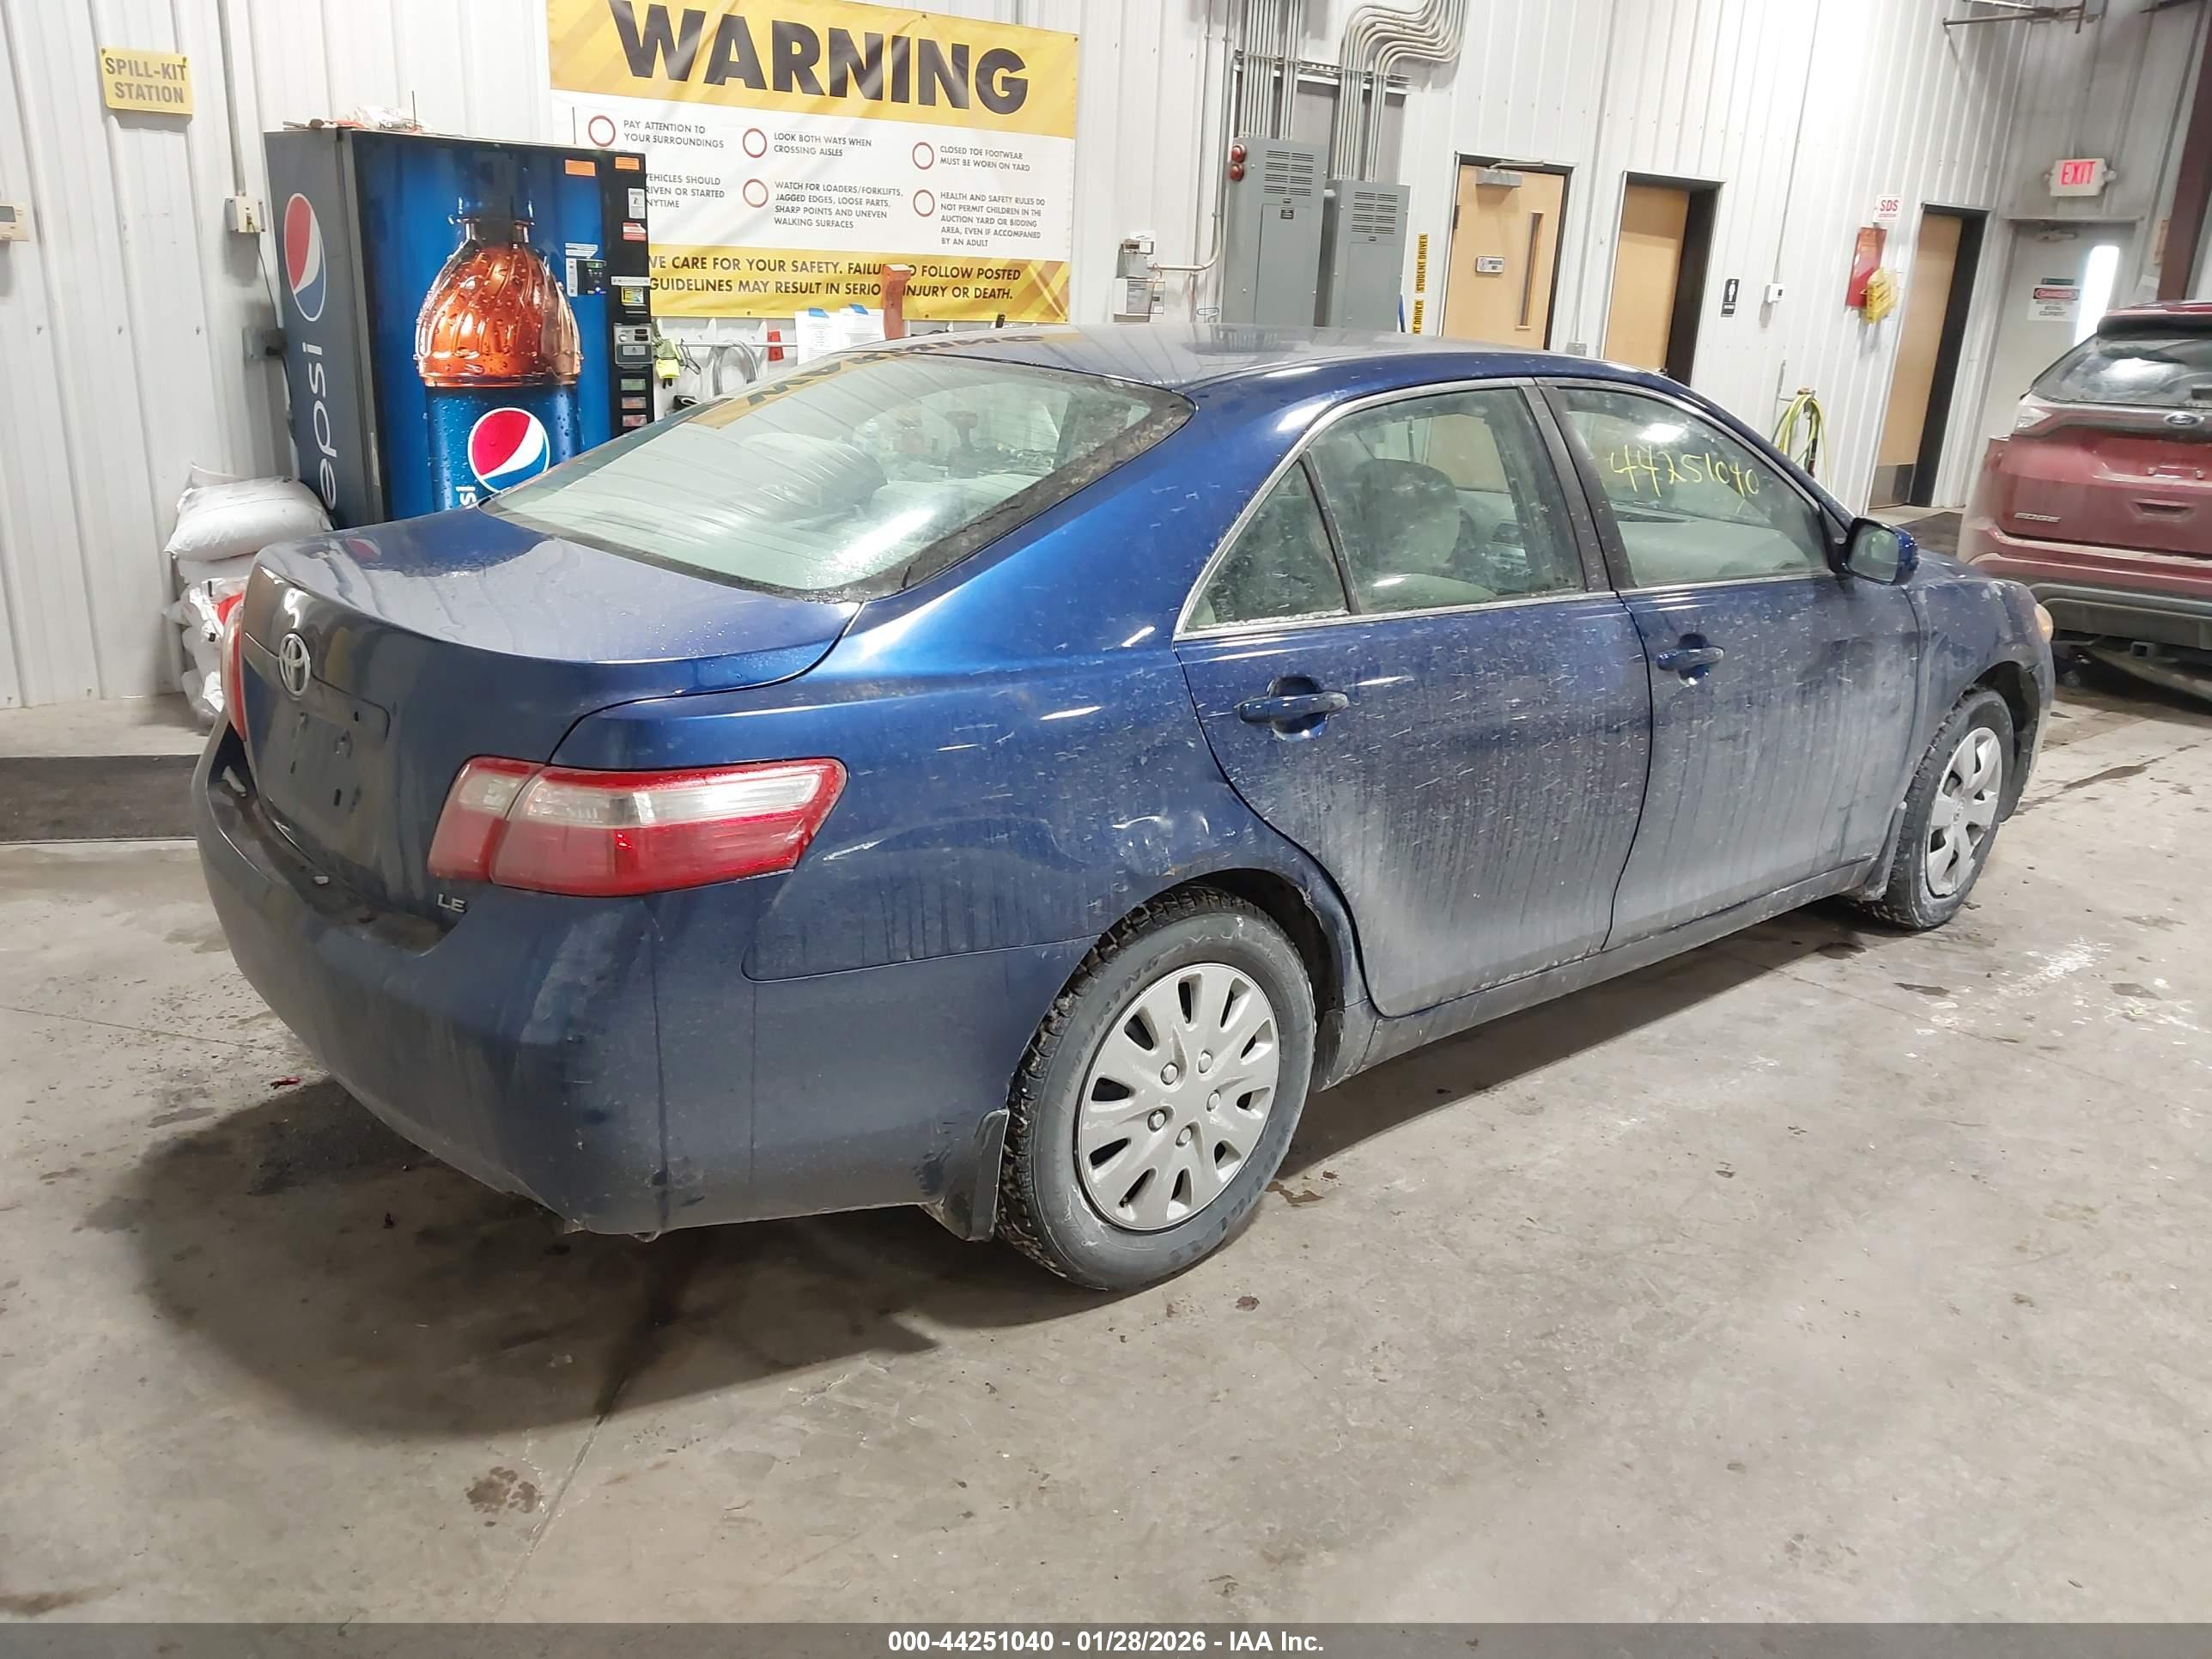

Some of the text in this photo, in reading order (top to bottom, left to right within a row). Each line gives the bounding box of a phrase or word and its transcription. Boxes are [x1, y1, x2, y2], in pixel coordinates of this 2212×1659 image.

[609, 0, 1029, 115] WARNING
[105, 57, 186, 81] SPILL-KIT
[114, 82, 185, 103] STATION
[624, 120, 706, 134] PAY ATTENTION TO
[624, 133, 724, 149] YOUR SURROUNDINGS
[775, 132, 872, 147] LOOK BOTH WAYS WHEN
[774, 145, 843, 156] CROSSING AISLES
[939, 146, 1023, 160] CLOSED TOE FOOTWEAR
[973, 160, 996, 168] WORN
[999, 161, 1010, 170] ON
[1012, 163, 1030, 172] YARD
[2061, 161, 2096, 185] EXIT
[687, 175, 720, 185] SHOULD
[775, 181, 803, 191] WATCH
[805, 182, 820, 191] FOR
[646, 185, 725, 198] RIVEN OR STARTED
[646, 198, 679, 208] NYTIME
[775, 194, 805, 203] JAGGED
[809, 196, 836, 204] EDGES,
[838, 198, 862, 206] LOOSE
[988, 196, 1013, 204] SAFETY
[1881, 199, 1899, 211] SDS
[804, 207, 833, 216] POINTS
[855, 210, 887, 218] UNEVEN
[958, 204, 983, 213] PERMIT
[986, 206, 1019, 216] CHILDREN
[774, 217, 854, 228] WALKING SURFACES
[941, 215, 974, 223] AUCTION
[975, 216, 994, 225] YARD
[941, 227, 962, 235] AREA,
[993, 229, 1041, 239] ACCOMPANIED
[672, 256, 708, 270] CARE
[713, 258, 742, 270] FOR
[745, 258, 787, 272] YOUR
[792, 260, 842, 274] SAFETY.
[848, 262, 885, 275] FAILU
[921, 264, 974, 279] FOLLOW
[977, 268, 1021, 280] POSTED
[1417, 234, 1427, 292] STUDENT DRIVER
[650, 277, 732, 292] GUIDELINES
[738, 280, 769, 293] MAY
[775, 282, 820, 294] RESULT
[826, 283, 840, 295] IN
[845, 283, 881, 295] SERIO
[903, 284, 948, 297] INJURY
[952, 287, 969, 299] OR
[974, 287, 1013, 300] DEATH.
[301, 342, 337, 510] epsi
[1608, 445, 1759, 498] 44251040
[438, 893, 466, 914] LE
